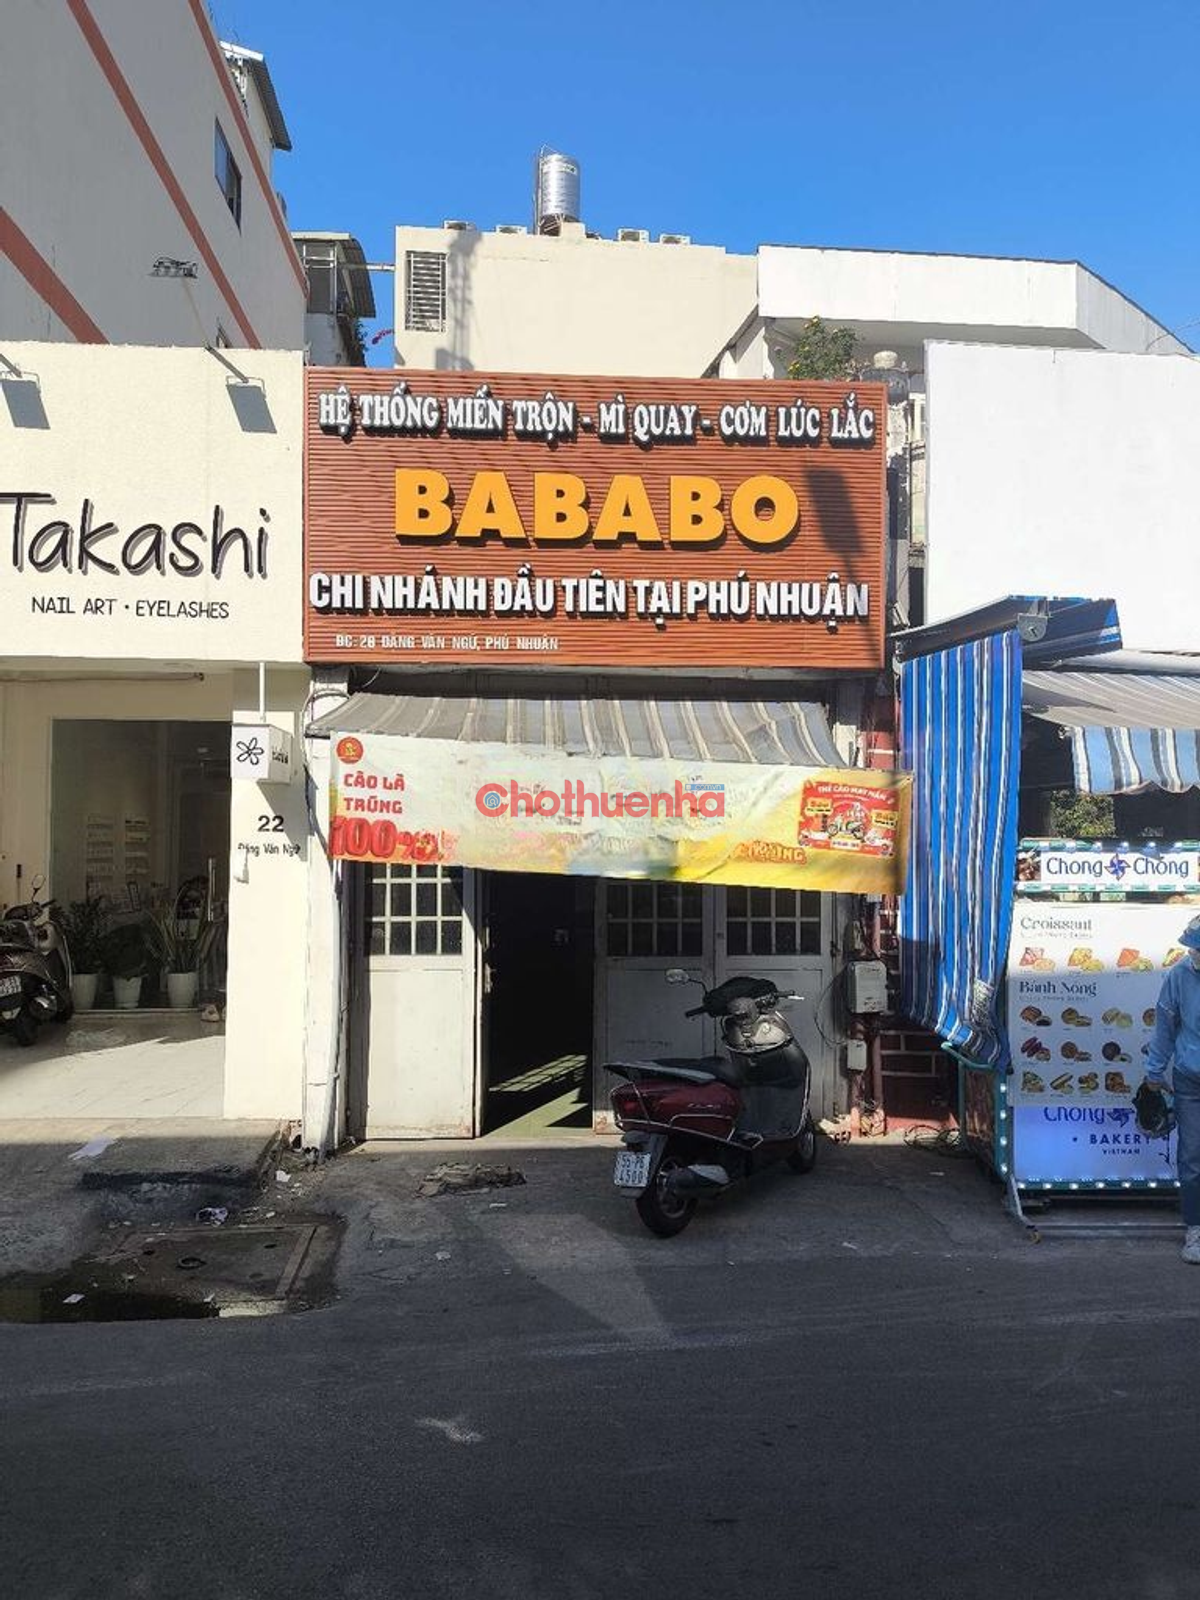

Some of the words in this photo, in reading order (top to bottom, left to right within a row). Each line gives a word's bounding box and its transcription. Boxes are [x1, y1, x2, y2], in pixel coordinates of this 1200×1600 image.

[319, 386, 351, 433] HỆ
[359, 381, 440, 428] THỐNG
[448, 384, 504, 431] MIẾN
[514, 392, 574, 440] TRỘN
[600, 394, 626, 434] MÌ
[633, 404, 697, 442] QUAY
[720, 401, 767, 436] CƠM
[777, 399, 820, 438] LÚC
[831, 391, 875, 439] LẮC
[0, 491, 271, 580] Takashi
[395, 468, 799, 545] BABABO
[31, 596, 76, 614] NAIL
[83, 598, 117, 616] ART
[135, 600, 230, 619] EYELASHES
[310, 572, 364, 609] CHI
[371, 565, 487, 611] NHÁNH
[493, 562, 555, 612] ĐẦU
[561, 569, 626, 613] TIÊN
[633, 578, 680, 625] TẠI
[687, 570, 750, 615] PHÚ
[756, 572, 869, 627] NHUẬN
[258, 815, 284, 832] 22
[1046, 856, 1103, 878] Chong
